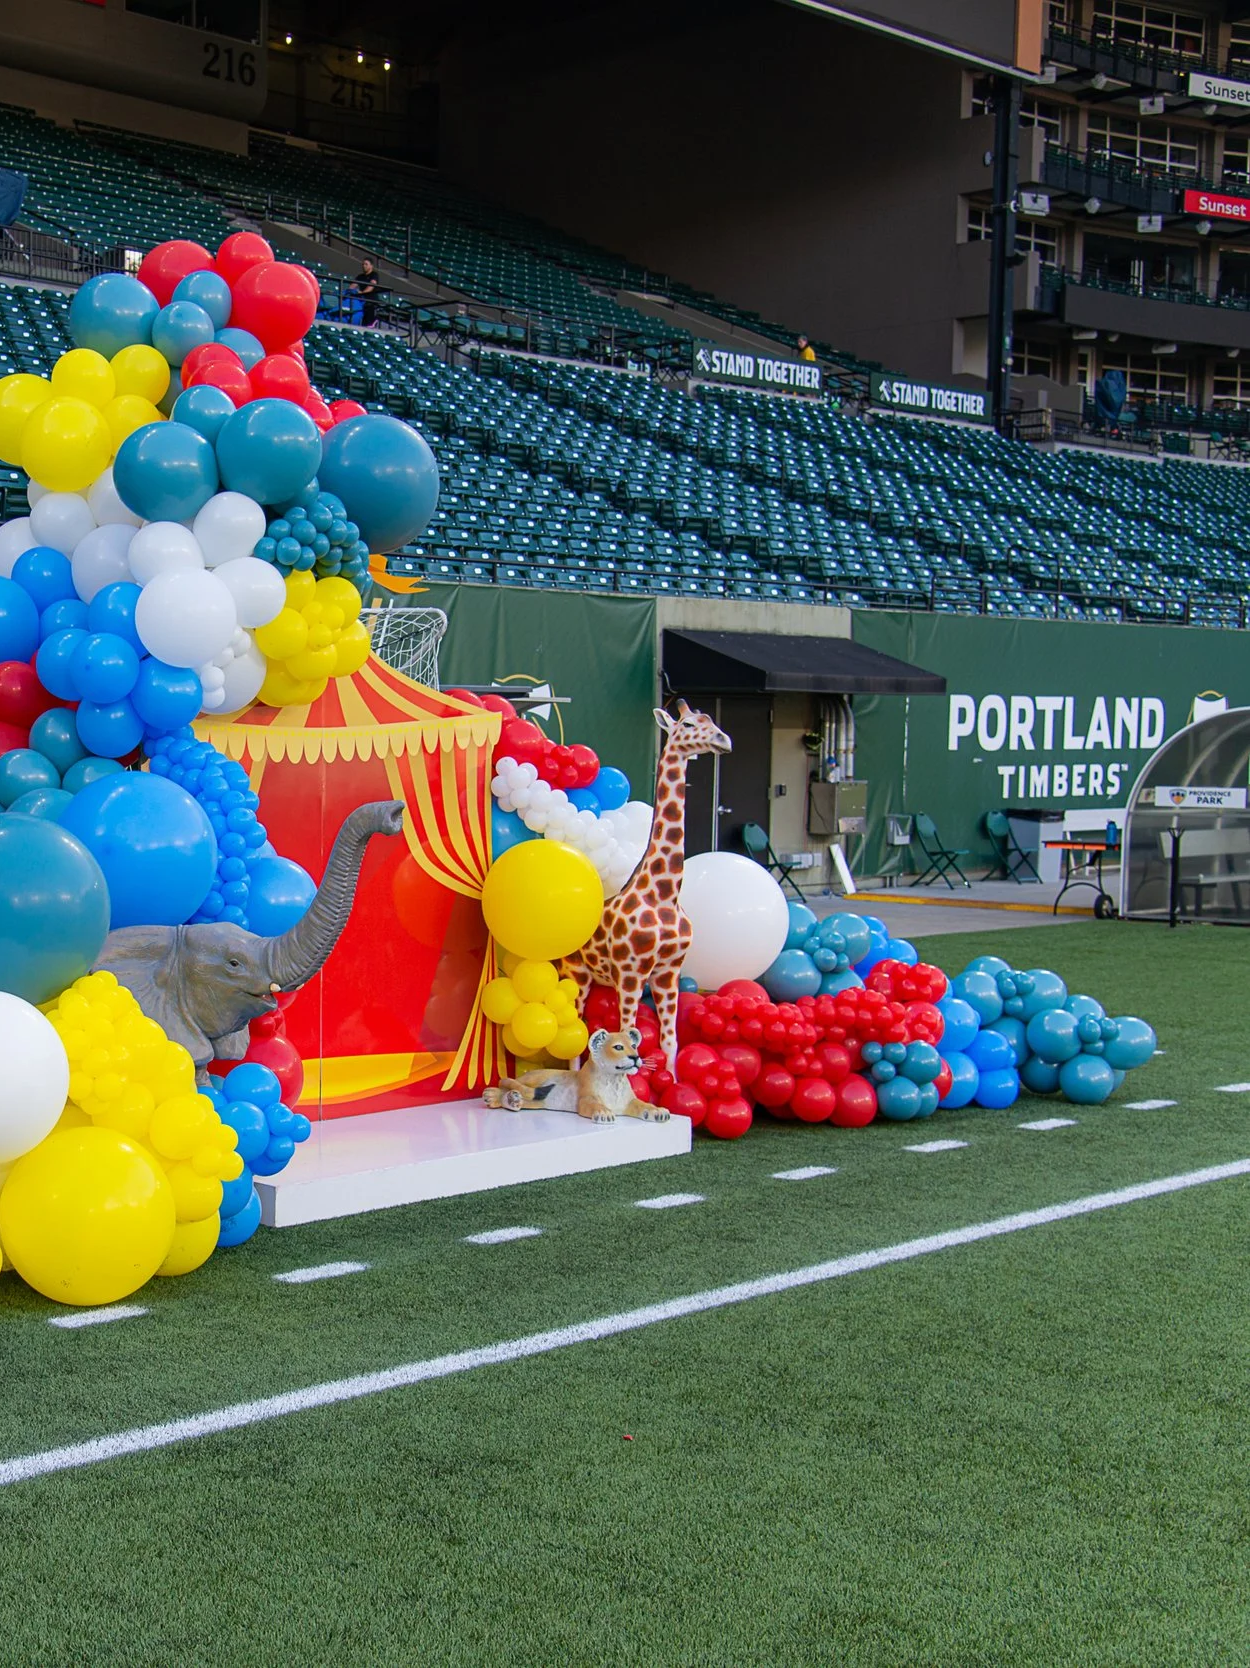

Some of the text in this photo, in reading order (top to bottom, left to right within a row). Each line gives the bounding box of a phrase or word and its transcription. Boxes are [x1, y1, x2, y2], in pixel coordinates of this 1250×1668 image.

[202, 42, 256, 87] 216
[1204, 81, 1250, 102] Sunset
[1199, 197, 1247, 217] Sunset
[712, 351, 820, 390] STAND TOGETHER
[892, 382, 984, 416] STAND TOGETHER
[948, 694, 1165, 751] PORTLAND
[1196, 797, 1223, 805] PARK
